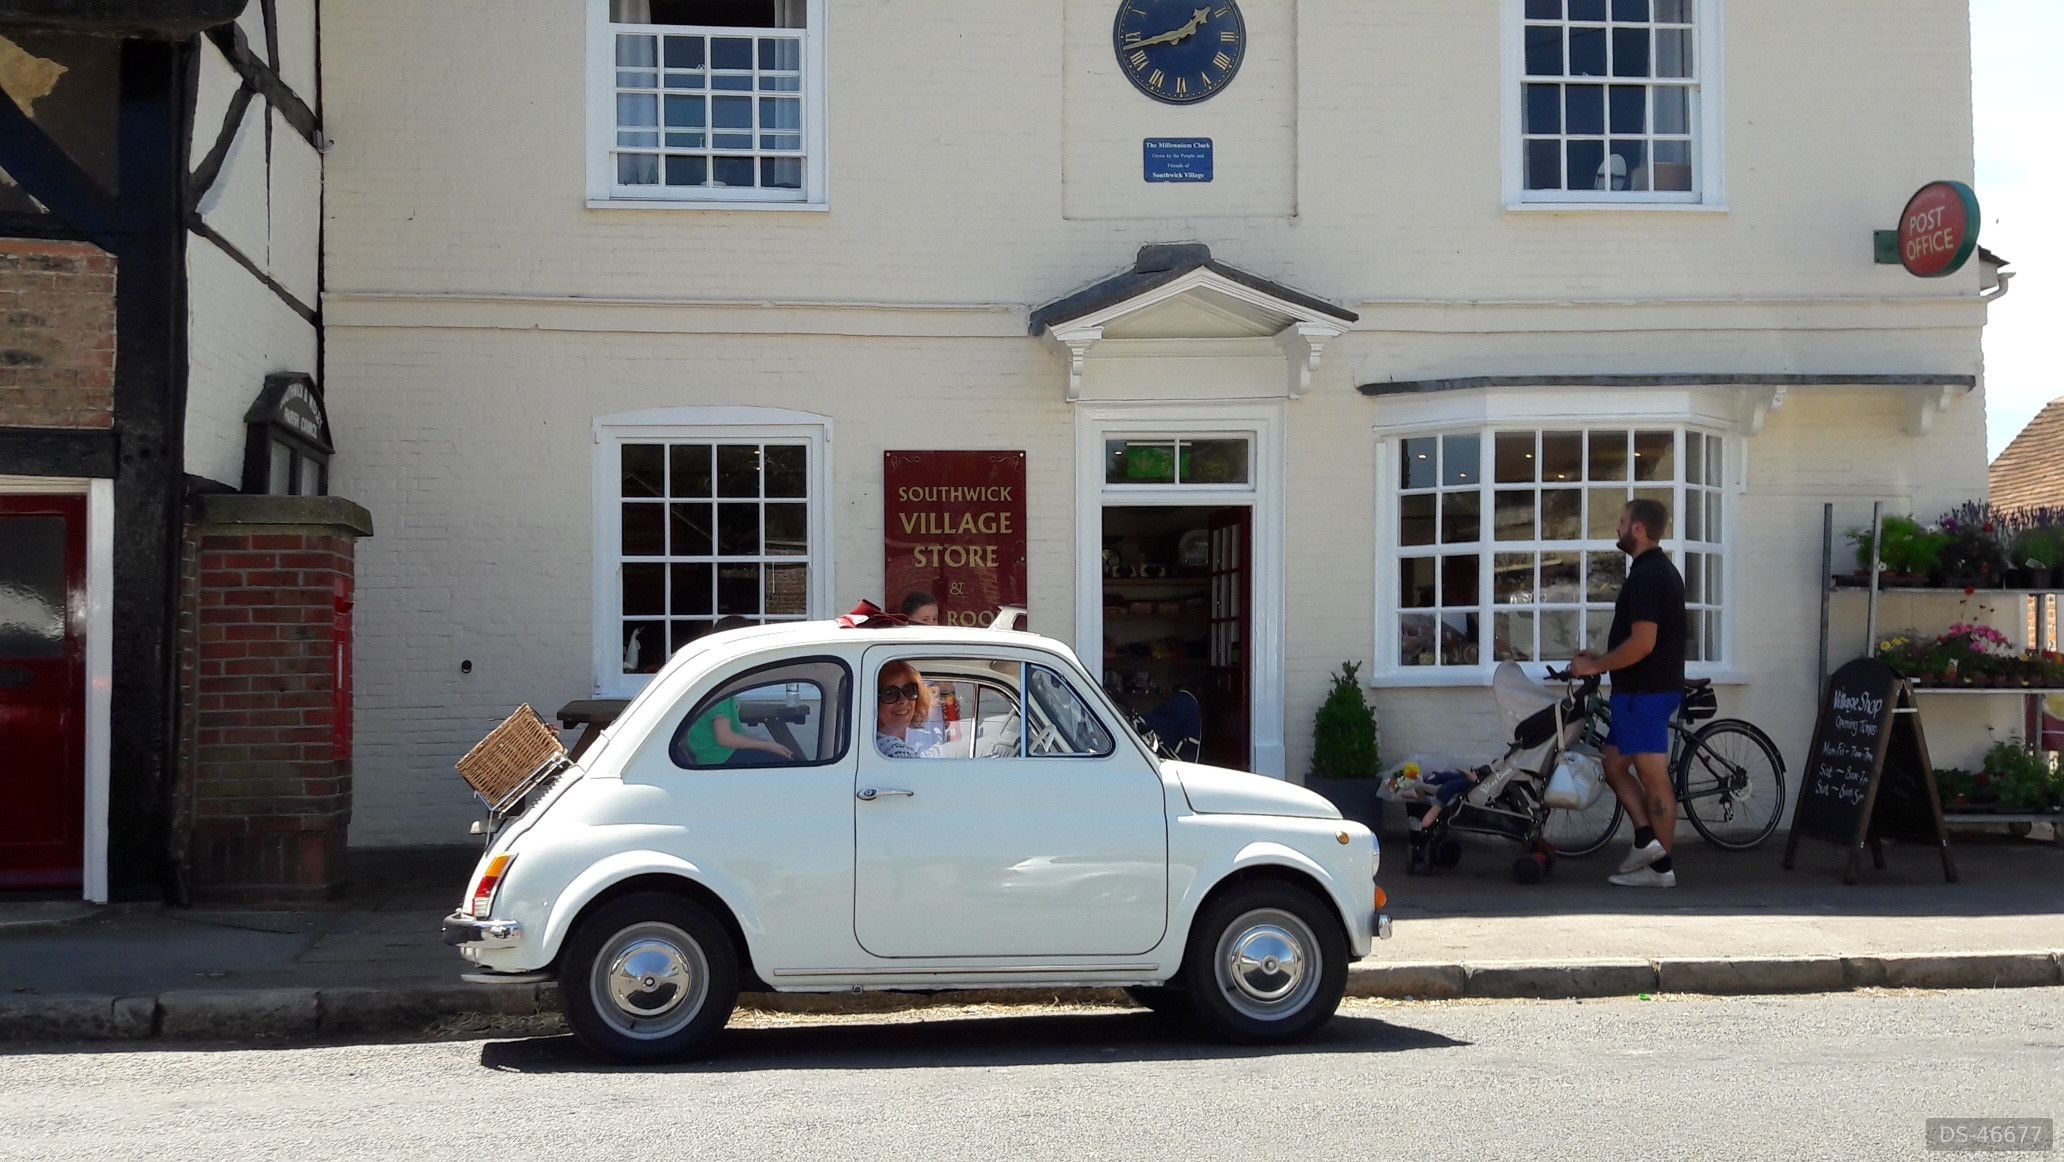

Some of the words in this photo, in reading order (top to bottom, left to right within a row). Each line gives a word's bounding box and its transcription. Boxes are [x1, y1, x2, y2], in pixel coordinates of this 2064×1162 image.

[1184, 172, 1204, 180] Village
[1909, 206, 1945, 236] POST
[1906, 228, 1954, 260] OFFICE
[898, 486, 1013, 502] SOUTHWICK
[899, 512, 1013, 535] VILLAGE
[914, 545, 999, 568] STORE
[950, 582, 965, 596] &
[947, 610, 996, 627] ROO
[1833, 687, 1859, 713] Village
[1858, 691, 1883, 719] Shop
